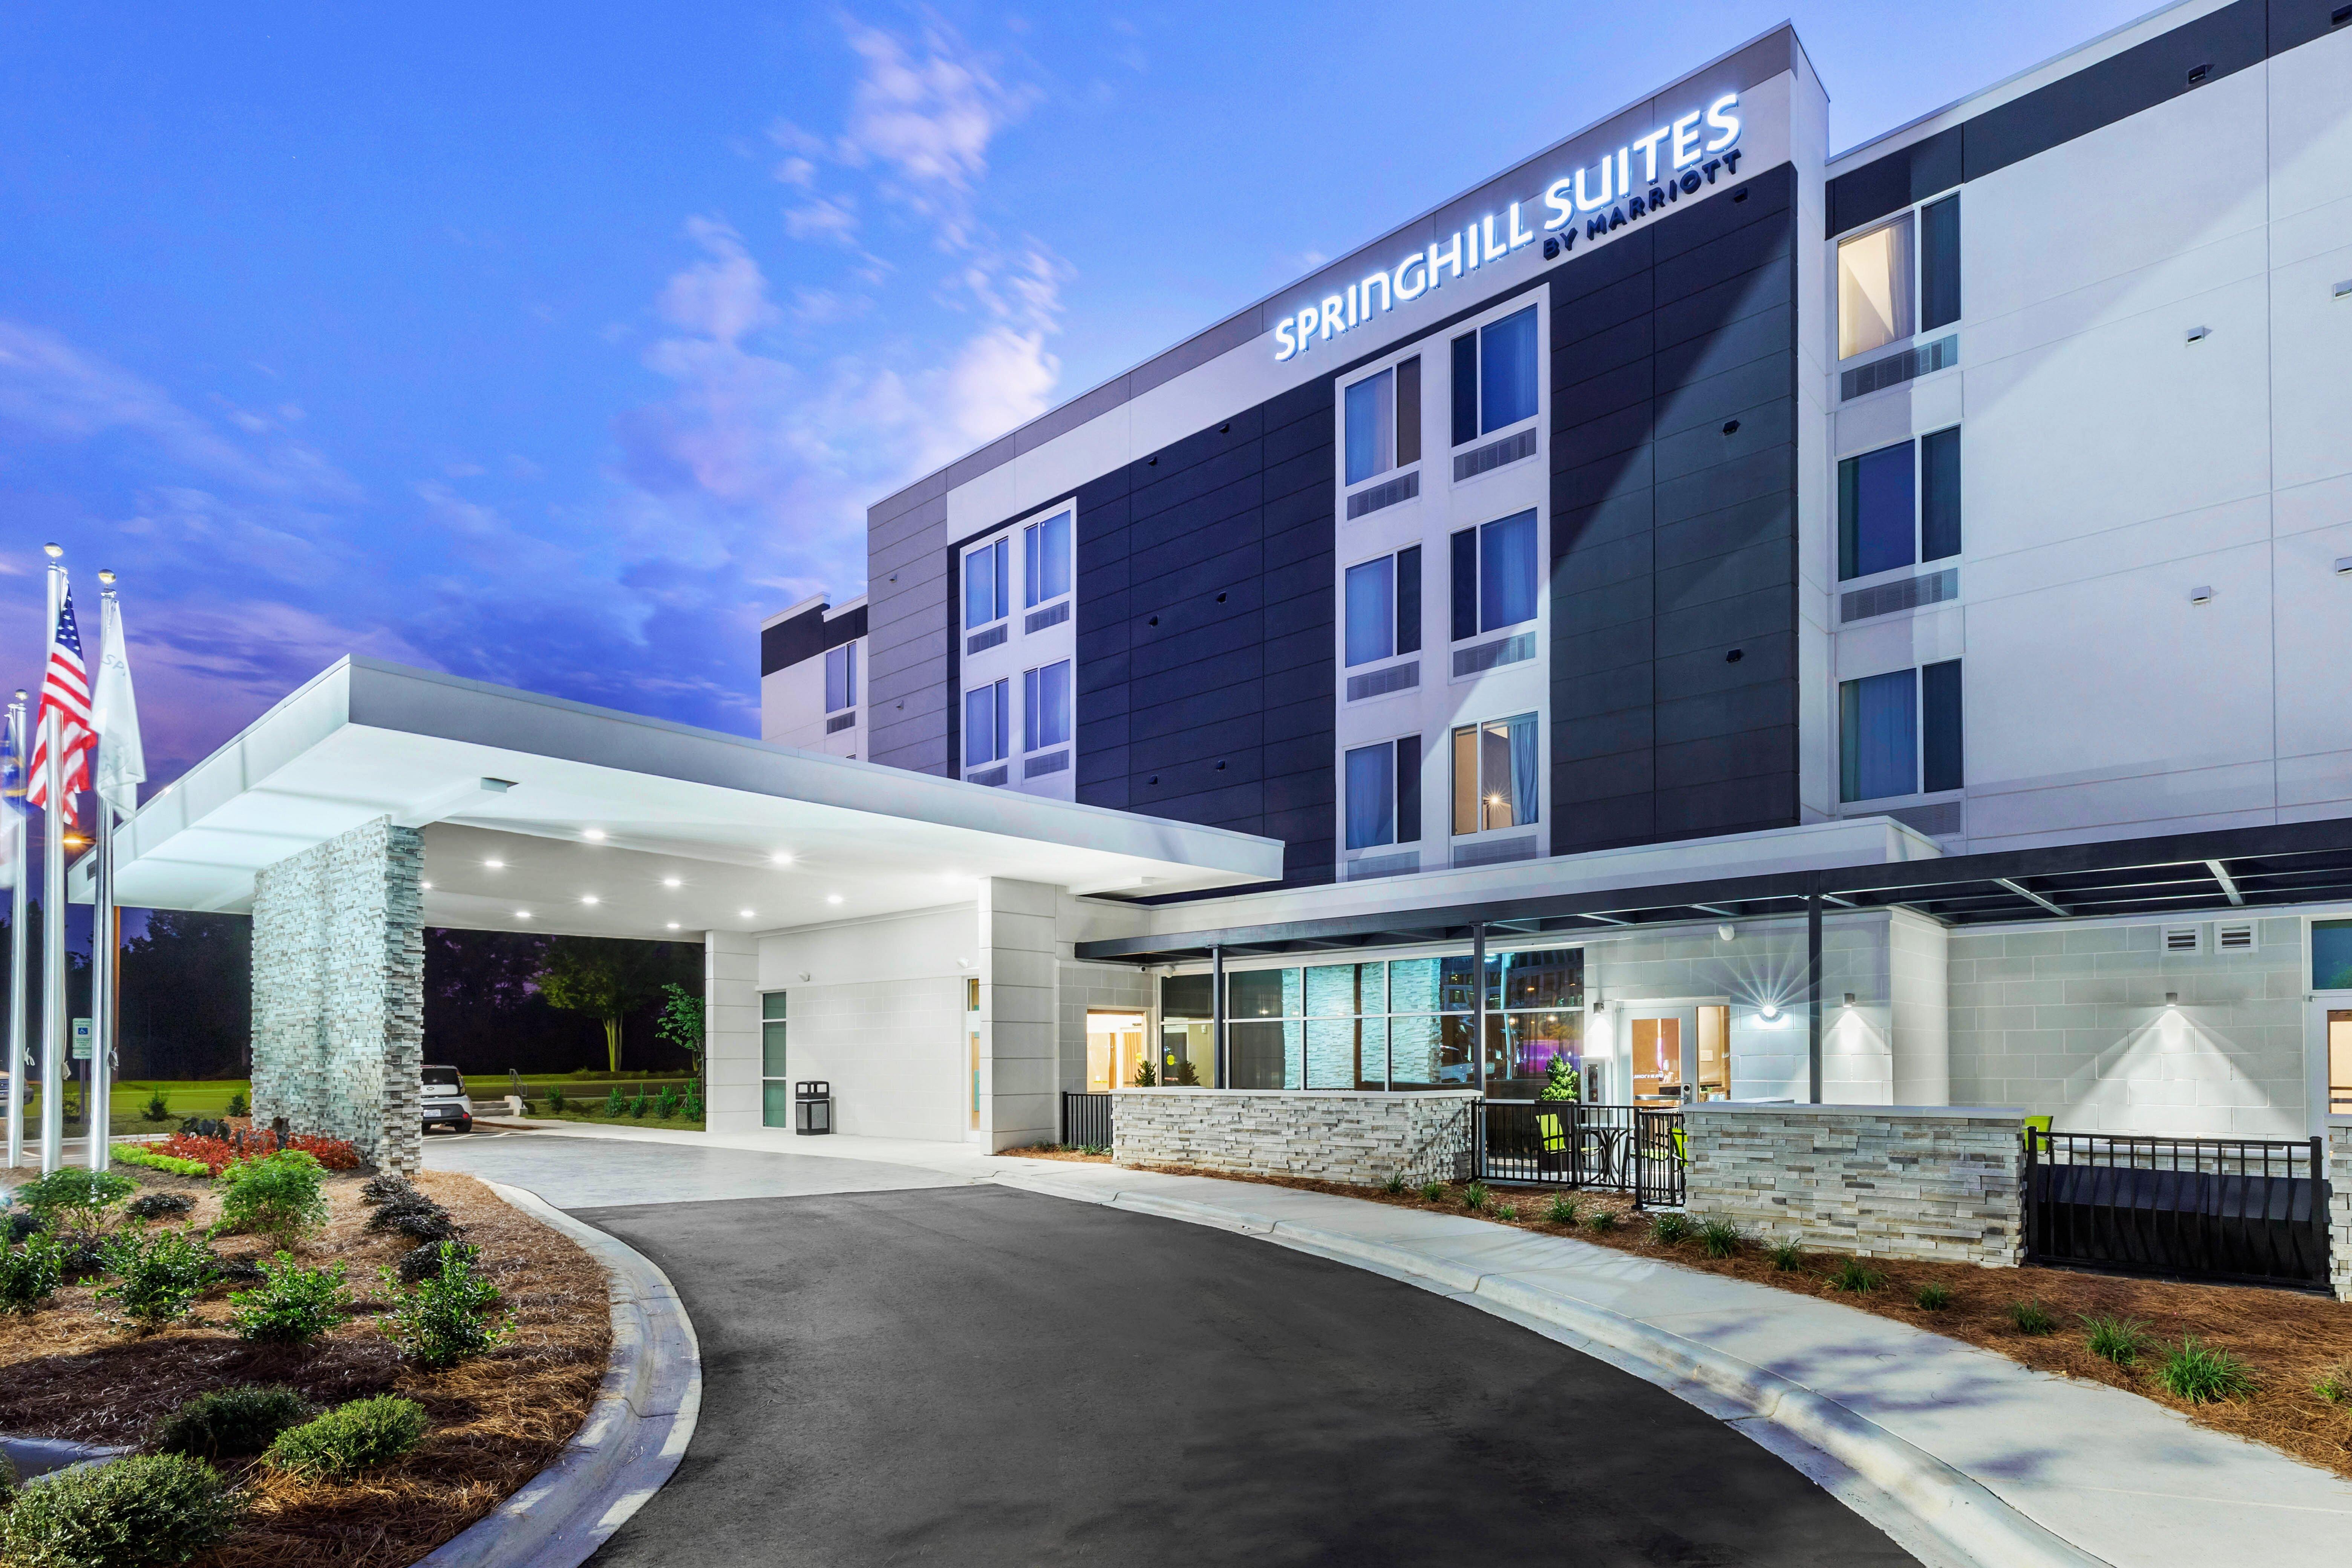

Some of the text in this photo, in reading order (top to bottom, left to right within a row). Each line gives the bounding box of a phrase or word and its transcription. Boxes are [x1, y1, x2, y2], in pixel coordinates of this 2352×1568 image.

[1275, 93, 1741, 361] SPRINGHILL SUITES
[1544, 148, 1741, 260] BY MARRIOTT
